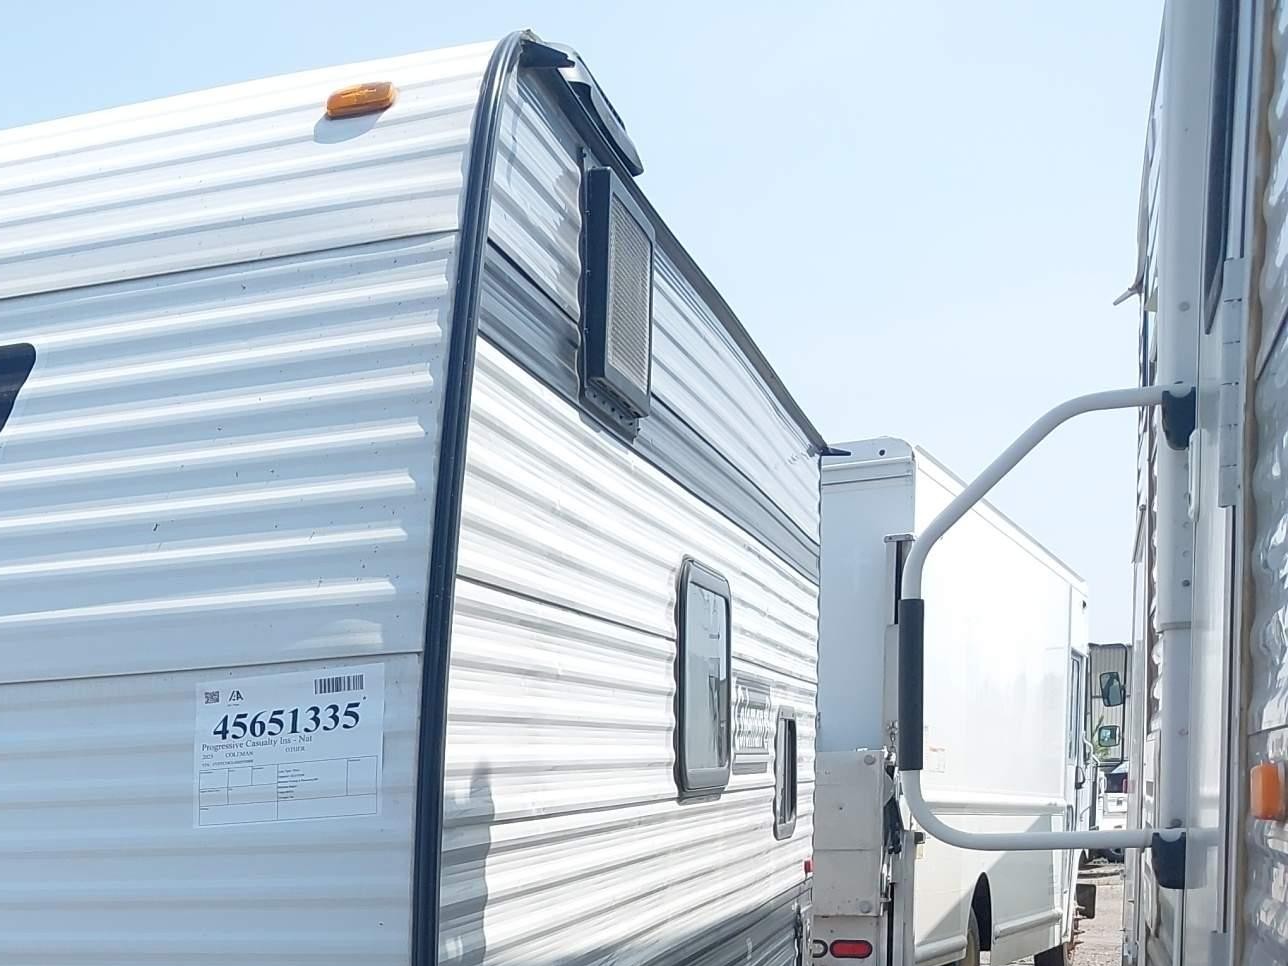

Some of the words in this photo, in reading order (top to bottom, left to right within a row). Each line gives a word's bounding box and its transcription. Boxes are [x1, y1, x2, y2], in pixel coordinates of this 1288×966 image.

[213, 702, 361, 740] 45651335
[202, 742, 244, 752] Progressive
[245, 738, 278, 748] Casualty
[280, 736, 291, 745] Ins
[299, 734, 313, 743] Nat
